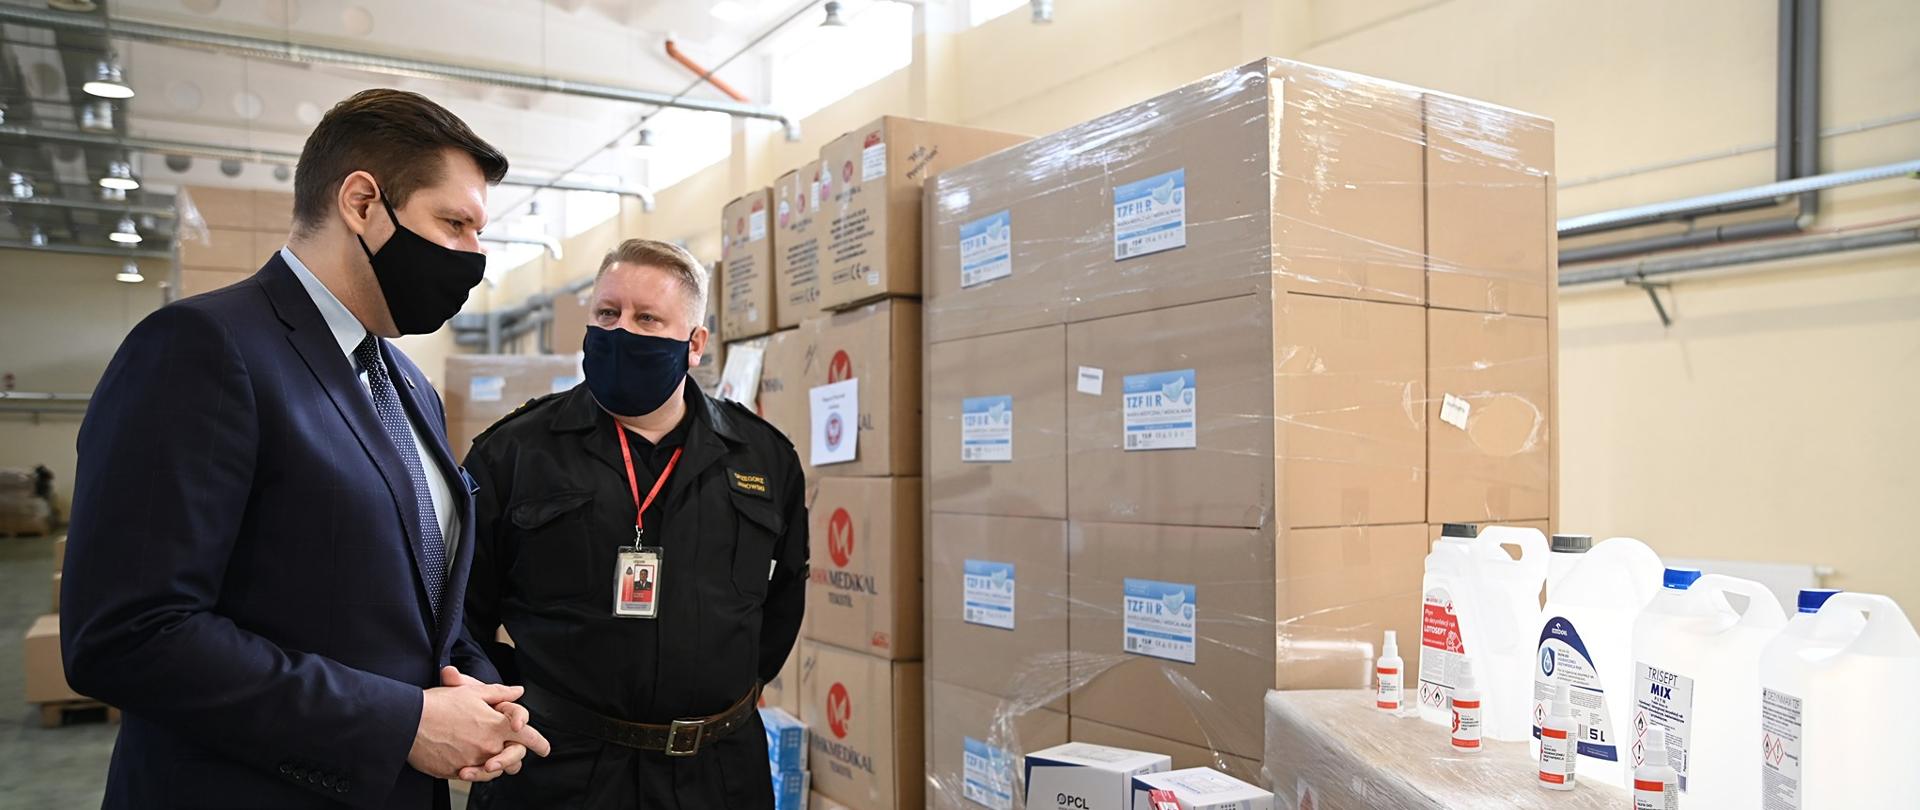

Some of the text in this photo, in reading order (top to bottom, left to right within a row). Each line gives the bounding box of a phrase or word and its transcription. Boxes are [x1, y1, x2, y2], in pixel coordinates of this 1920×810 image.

[1117, 204, 1134, 218] TZF
[1127, 396, 1144, 408] TZF
[1155, 394, 1162, 407] R
[966, 577, 979, 589] TZF
[1128, 599, 1144, 612] TZF
[1156, 602, 1162, 616] R
[1648, 666, 1678, 686] TRISEPT
[1650, 683, 1672, 700] MIX
[1067, 796, 1090, 810] PCL
